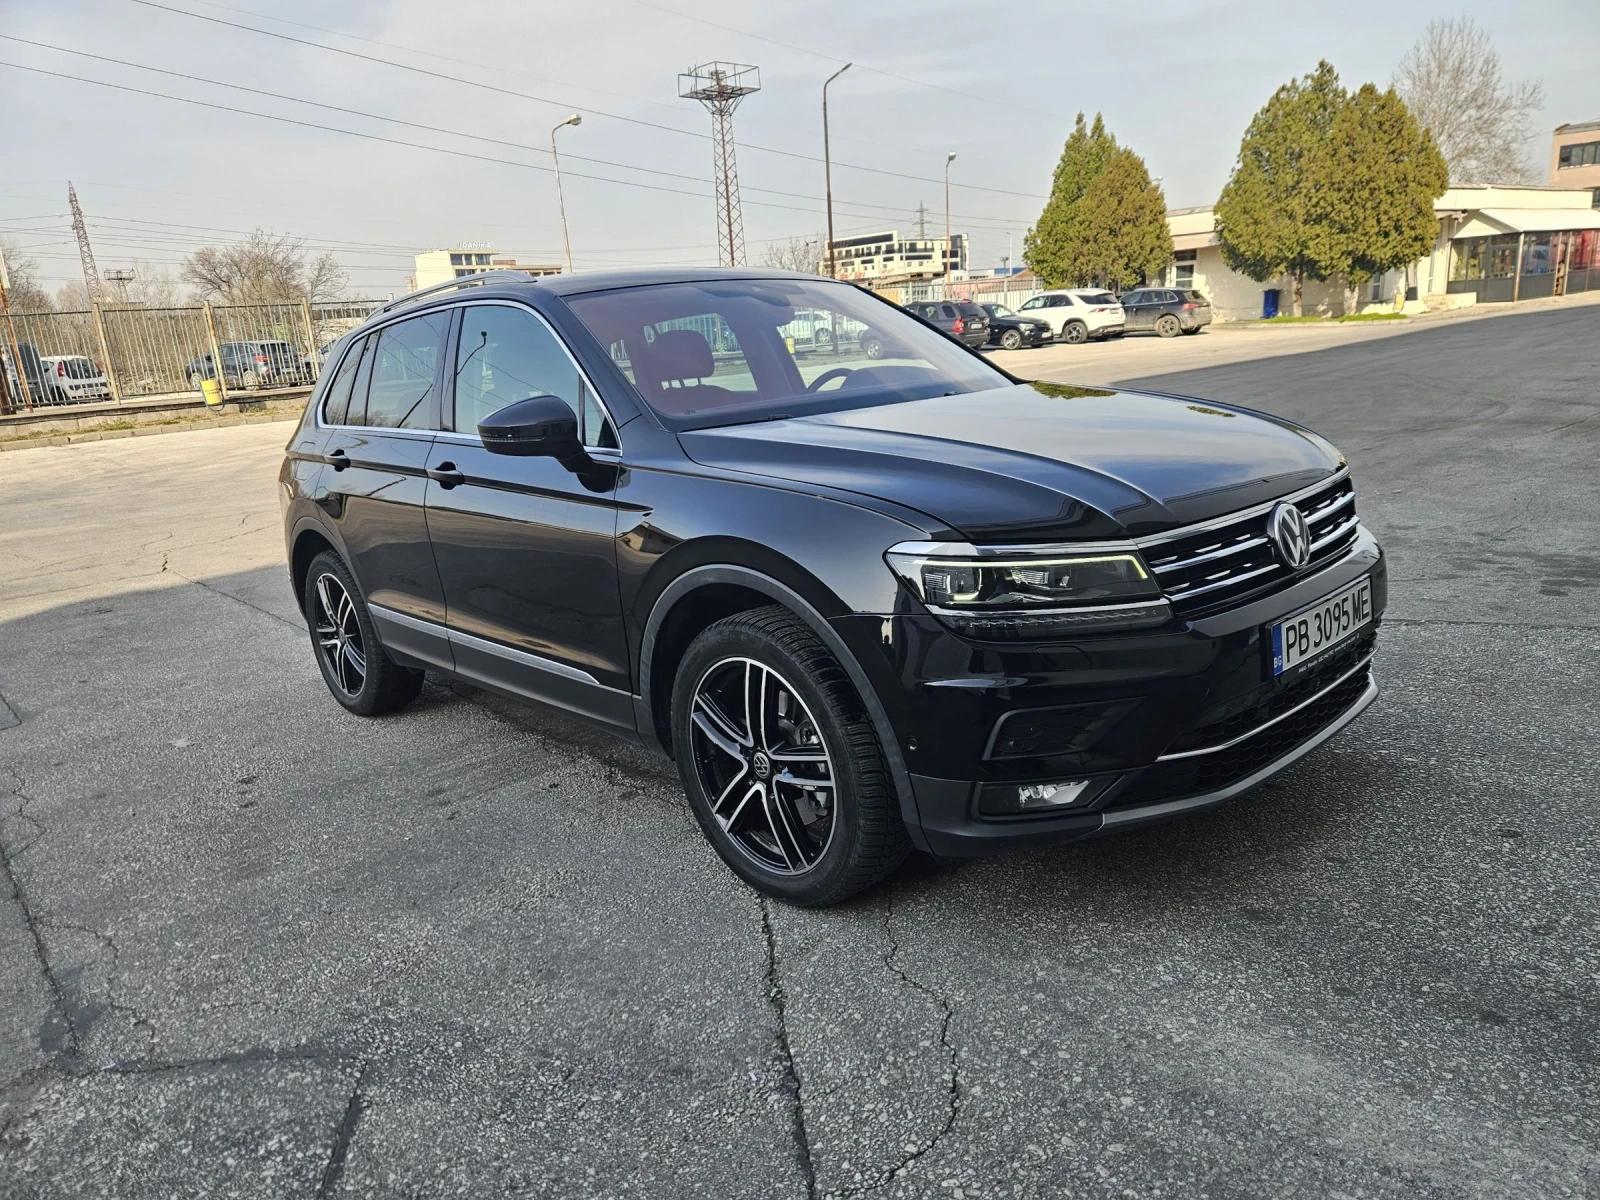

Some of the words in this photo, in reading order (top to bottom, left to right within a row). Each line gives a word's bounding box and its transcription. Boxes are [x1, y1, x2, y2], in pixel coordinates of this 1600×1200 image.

[1275, 504, 1311, 569] VW
[1286, 619, 1310, 664] PB
[1313, 596, 1350, 648] 3095
[1352, 584, 1370, 626] ME
[1273, 655, 1282, 669] BG
